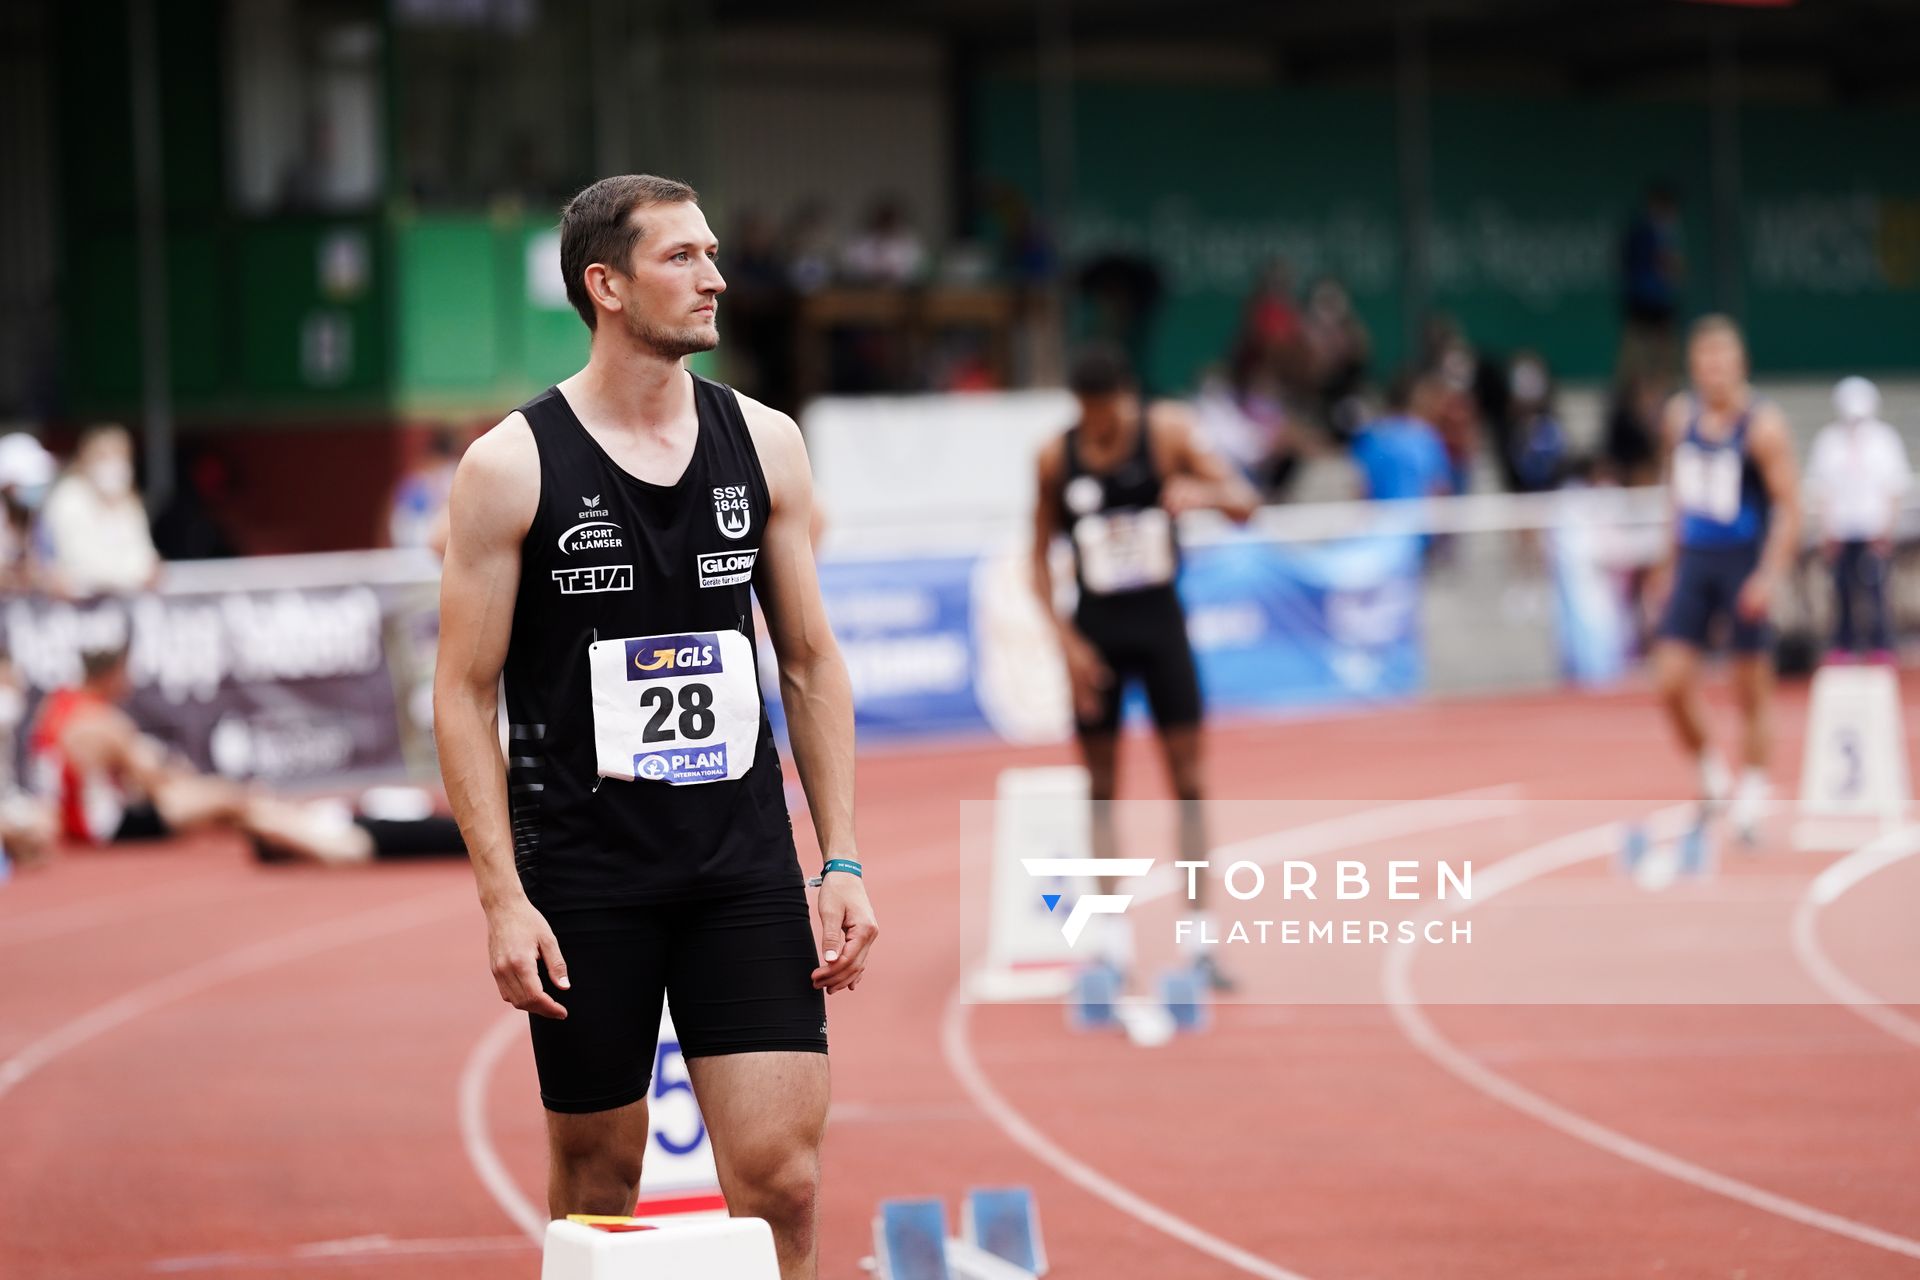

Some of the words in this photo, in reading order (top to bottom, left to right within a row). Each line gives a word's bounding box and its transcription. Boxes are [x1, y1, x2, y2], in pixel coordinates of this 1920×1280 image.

[713, 486, 746, 500] SSV
[714, 499, 749, 511] 1846
[578, 508, 609, 519] erima
[580, 529, 613, 540] SPORT
[571, 539, 623, 551] KLAMSER
[553, 566, 632, 593] TEVA
[676, 645, 713, 668] GLS
[640, 683, 716, 743] 28
[671, 751, 723, 770] PLAN
[673, 769, 724, 778] INTERNATIONAL
[653, 1042, 706, 1155] 5
